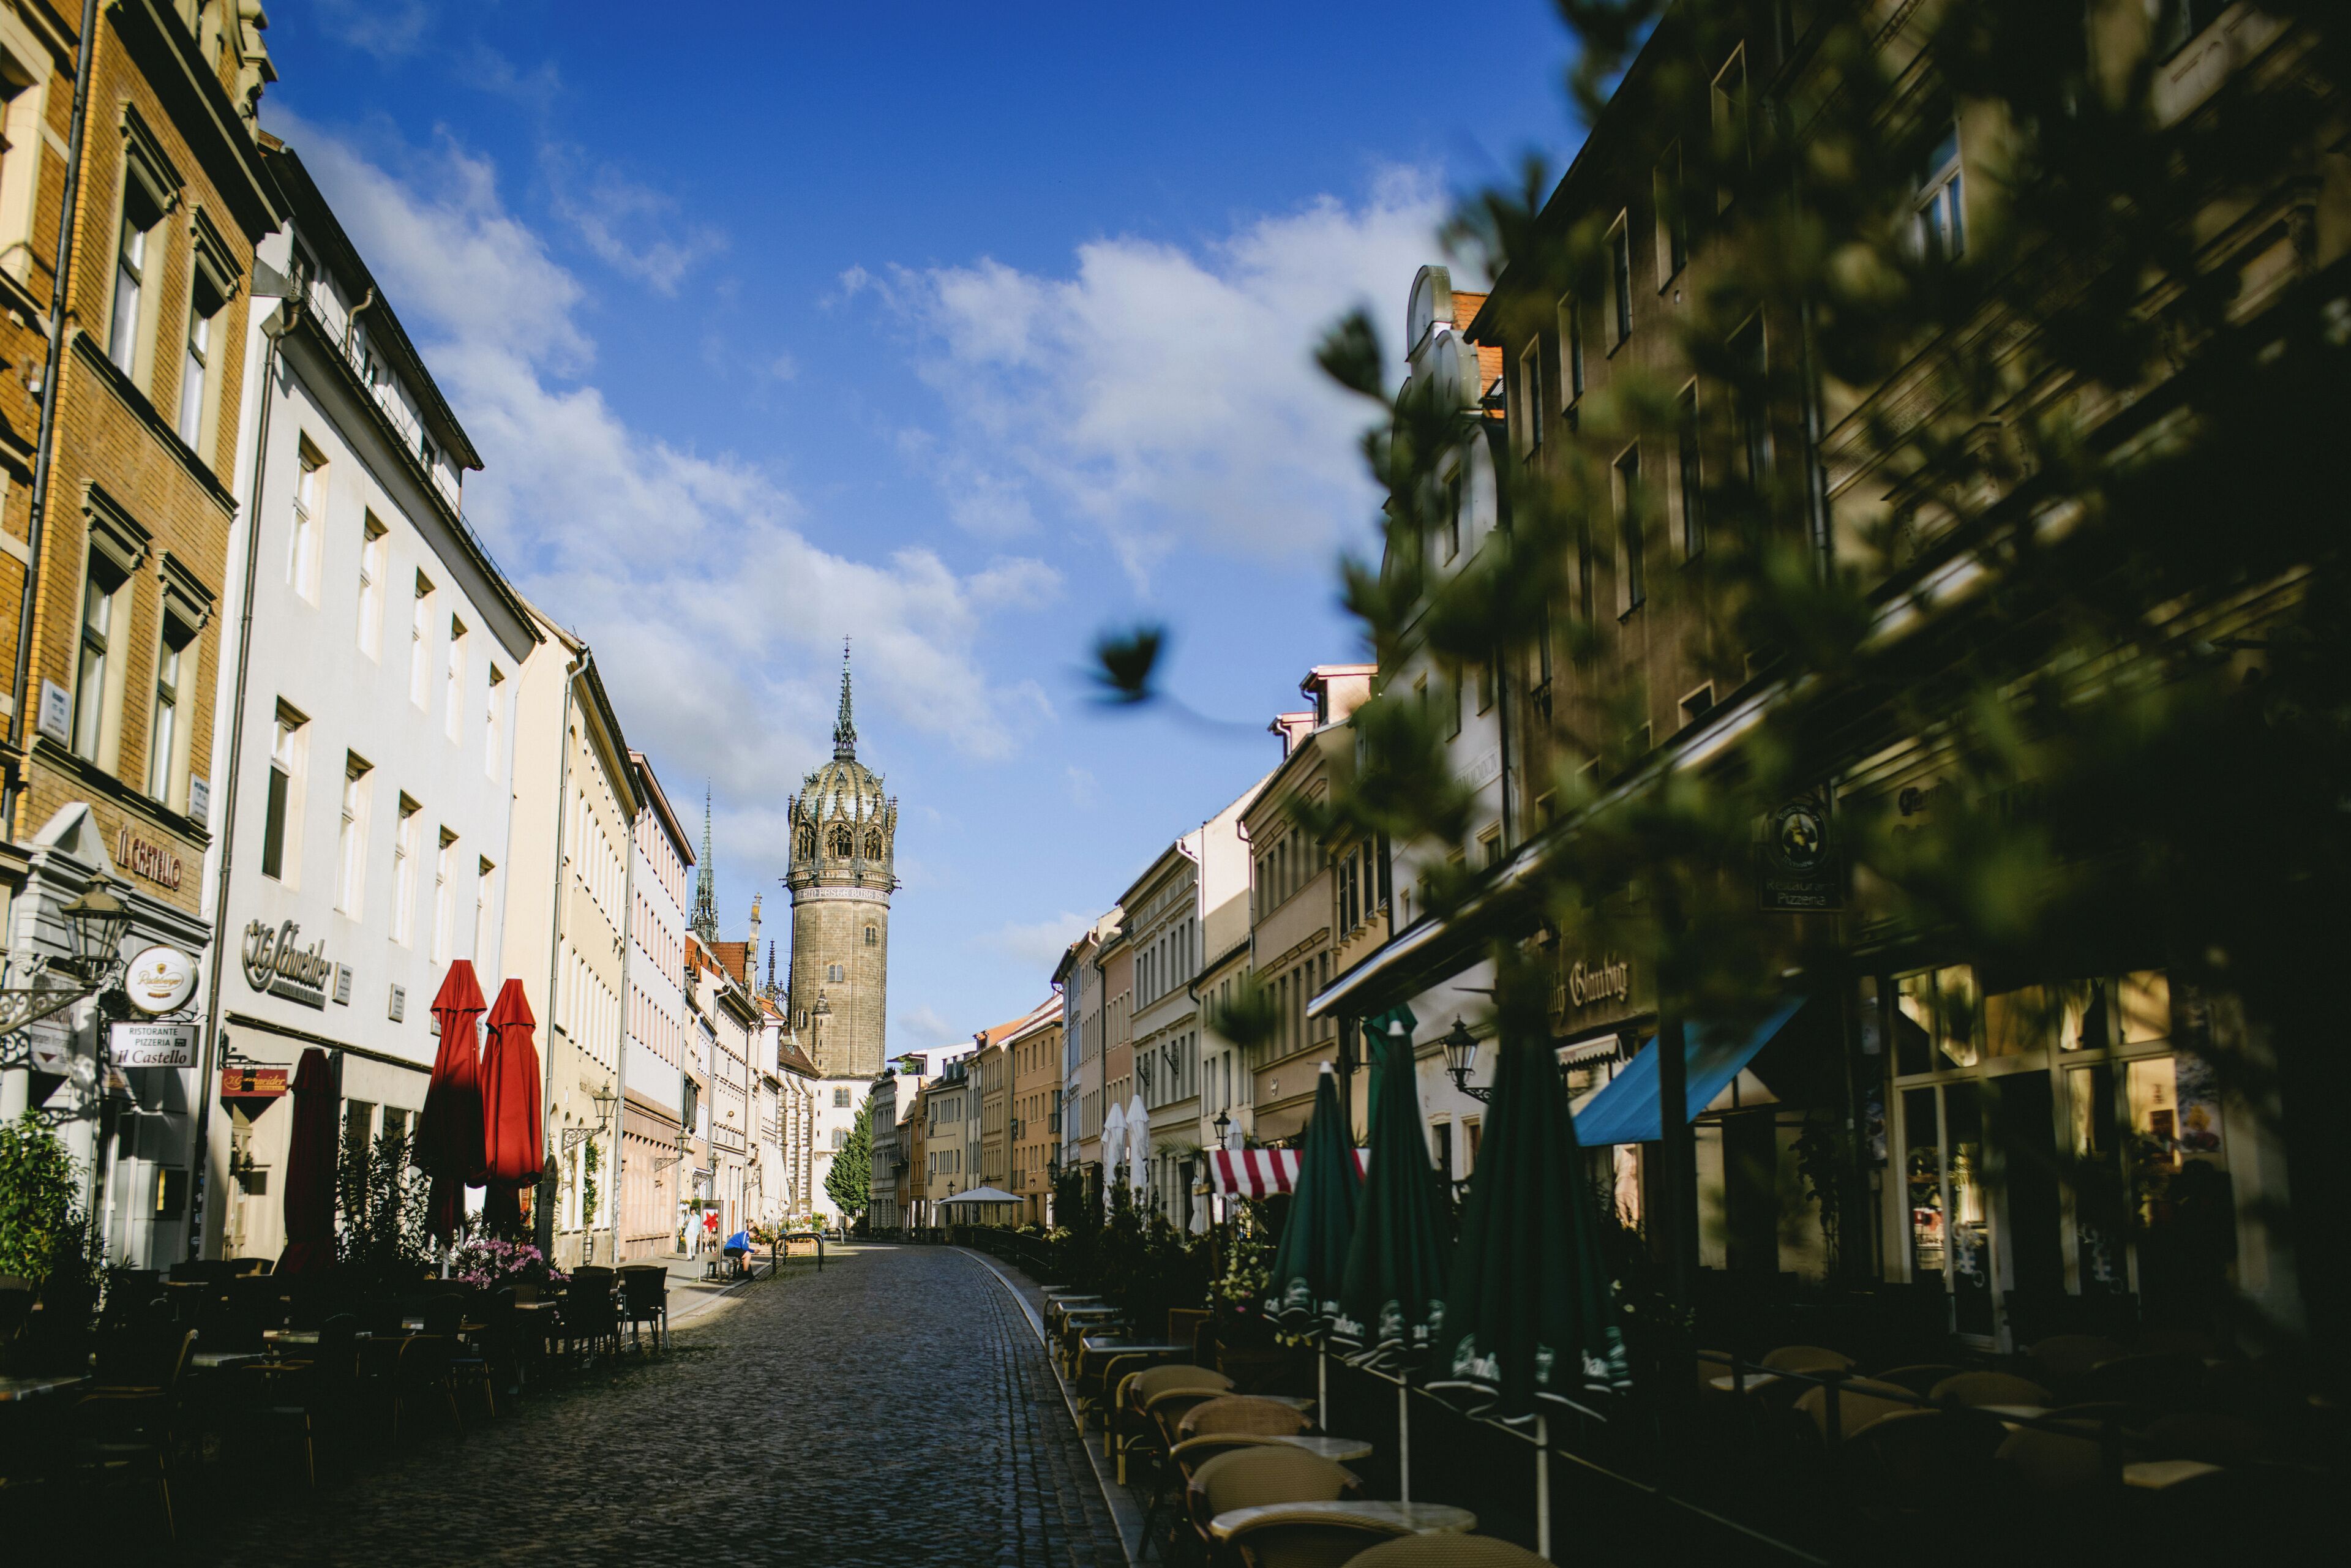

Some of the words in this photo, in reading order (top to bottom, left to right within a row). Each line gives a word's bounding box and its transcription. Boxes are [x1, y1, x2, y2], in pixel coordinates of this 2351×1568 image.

[130, 838, 182, 890] CASTELLO
[803, 889, 816, 898] EIN
[819, 888, 849, 898] FESTE
[851, 889, 874, 899] BURG
[129, 1027, 178, 1036] RISTORANTE
[116, 1049, 129, 1063] Il
[132, 1049, 187, 1064] Castello
